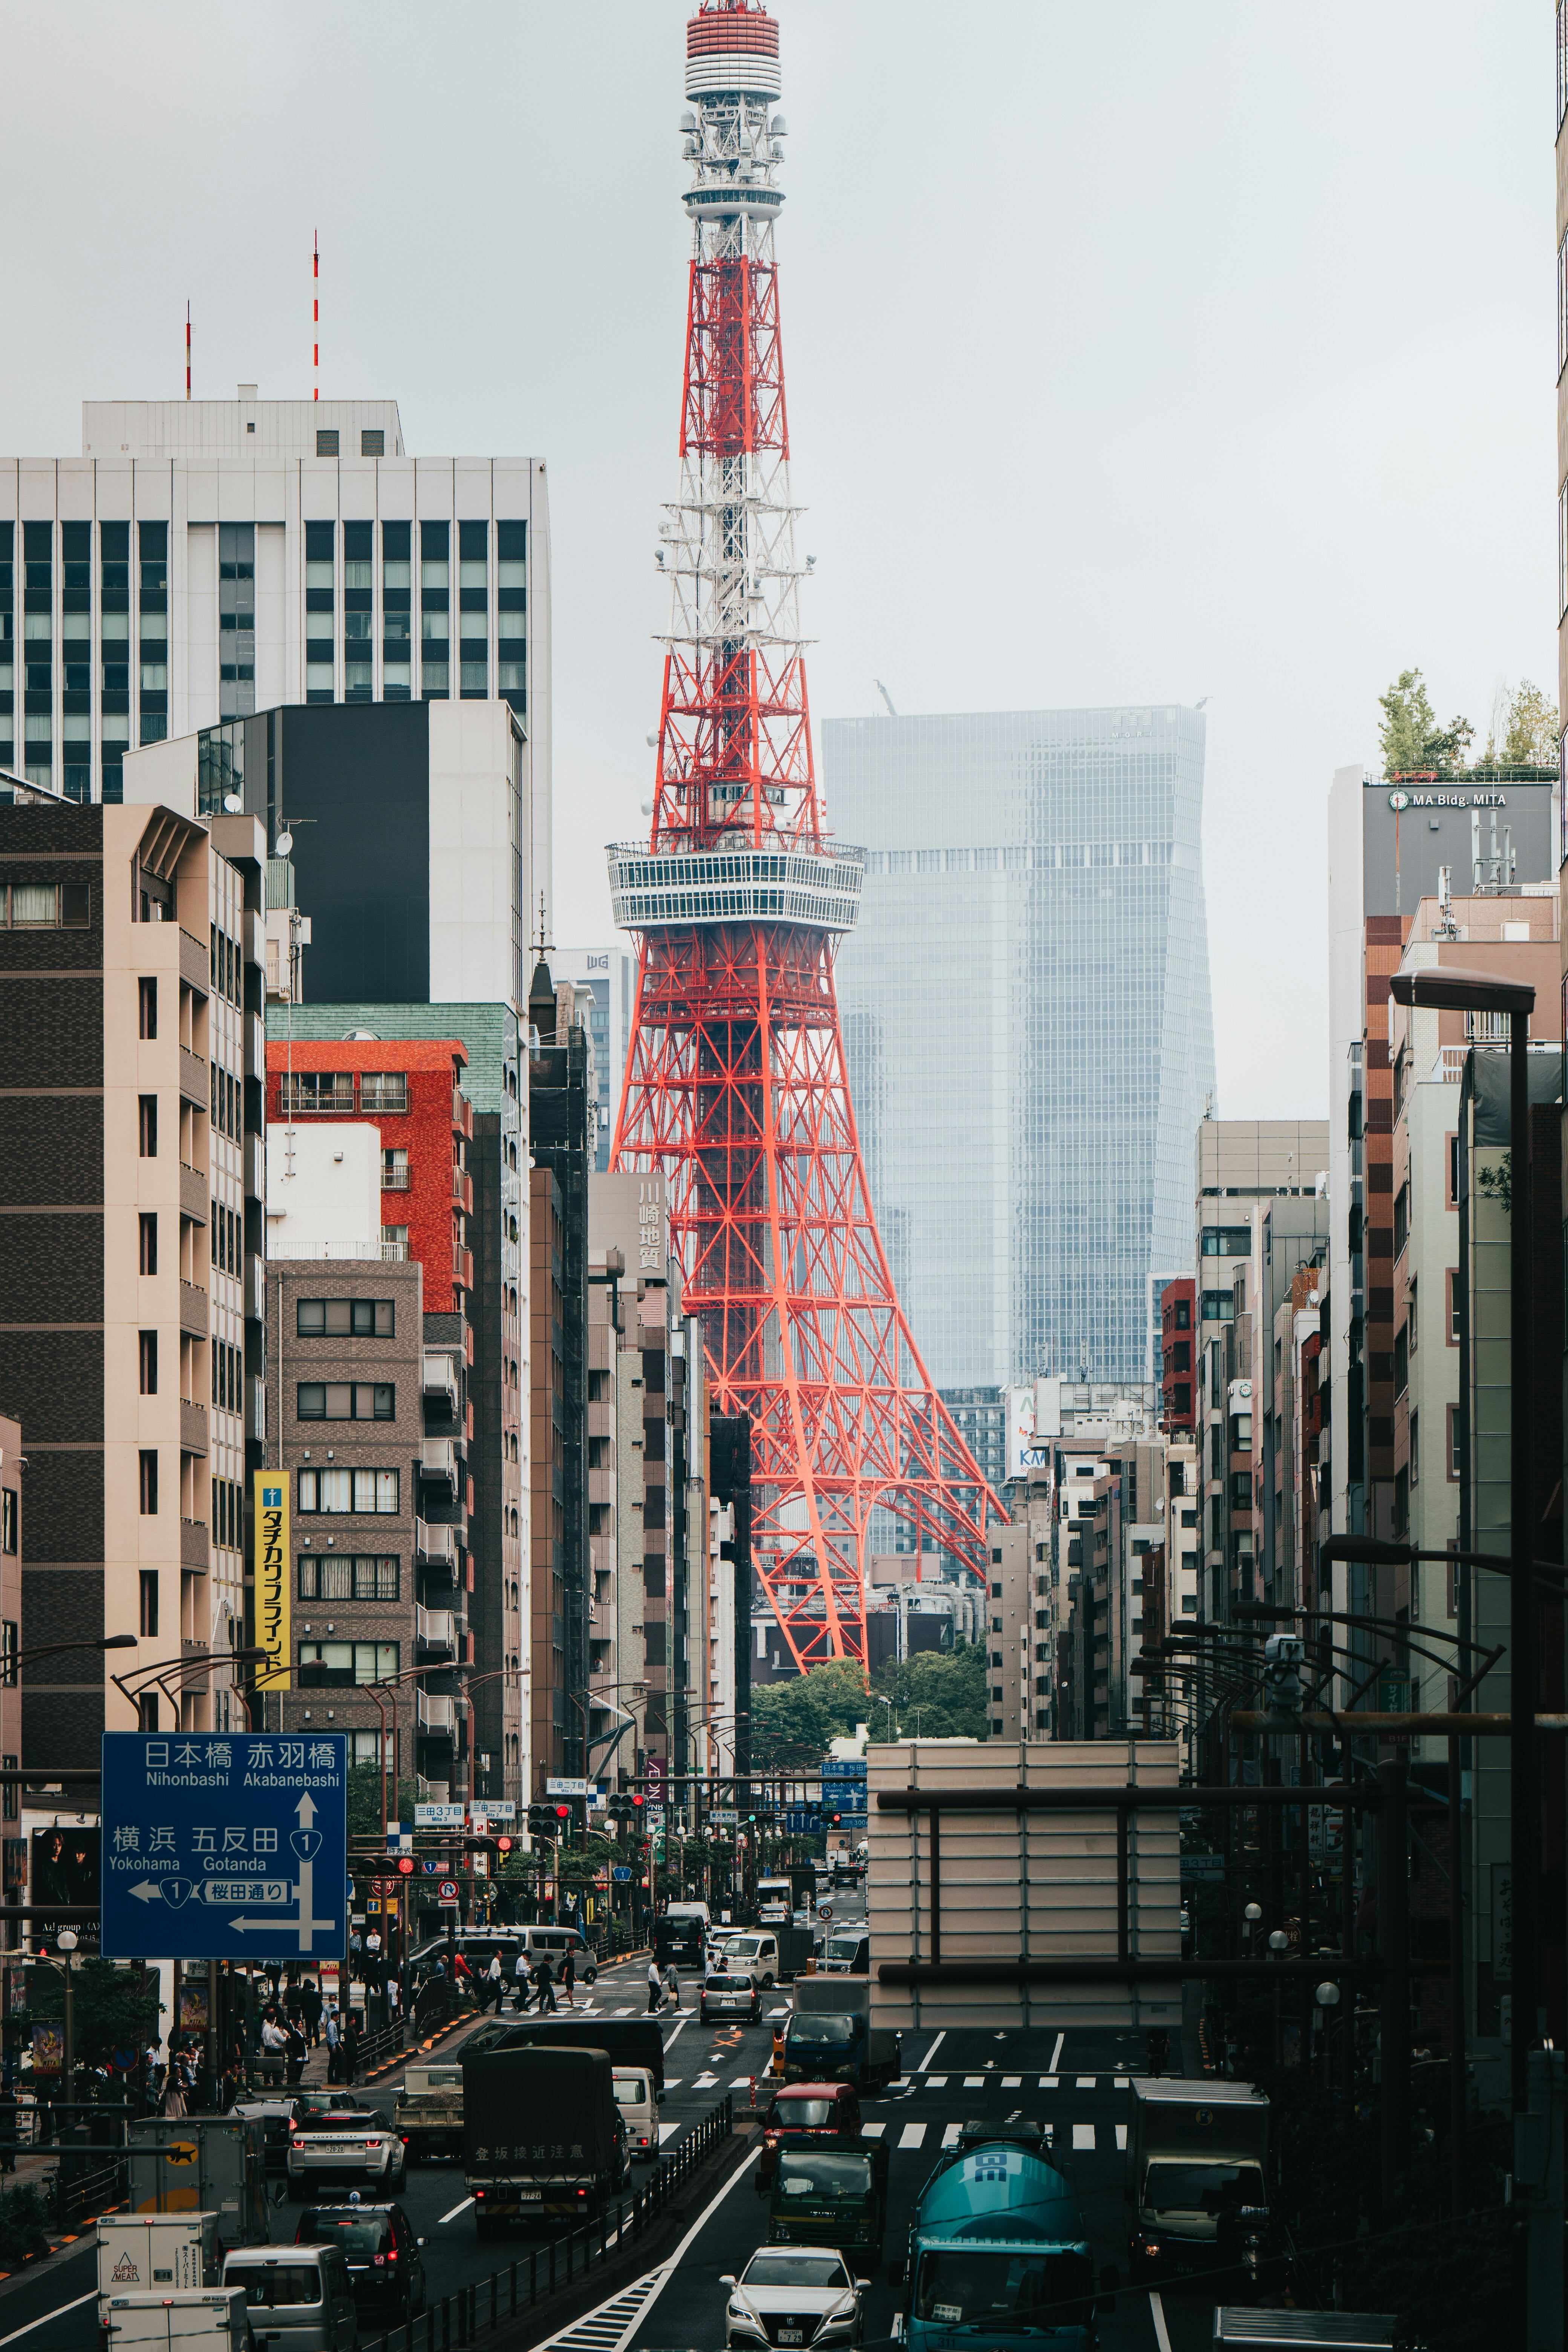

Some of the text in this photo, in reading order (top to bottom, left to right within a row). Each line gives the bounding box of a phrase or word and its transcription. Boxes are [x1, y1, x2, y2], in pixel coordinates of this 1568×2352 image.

[1413, 794, 1506, 807] MA Bldg. MITA
[639, 1182, 660, 1269] 川崎地質
[263, 1511, 282, 1672] タチカワブラインド
[146, 1741, 336, 1769] 日本橋 赤羽橋
[146, 1772, 340, 1787] Nihonbashi Akabanebashi
[417, 1807, 462, 1816] 三田3丁目
[1309, 1807, 1321, 1847] 龍祥軒
[113, 1826, 278, 1852] 横浜 五反田
[302, 1834, 309, 1851] 1
[109, 1856, 266, 1871] Yokohama Gotanda
[1180, 1859, 1222, 1867] 田3丁目
[172, 1882, 179, 1899] 1
[211, 1883, 282, 1900] 桜田通り
[57, 1924, 81, 1934] group
[475, 2144, 584, 2161] 登坂接近注意
[934, 2305, 958, 2314] 関東宇部
[937, 2337, 955, 2348] 311
